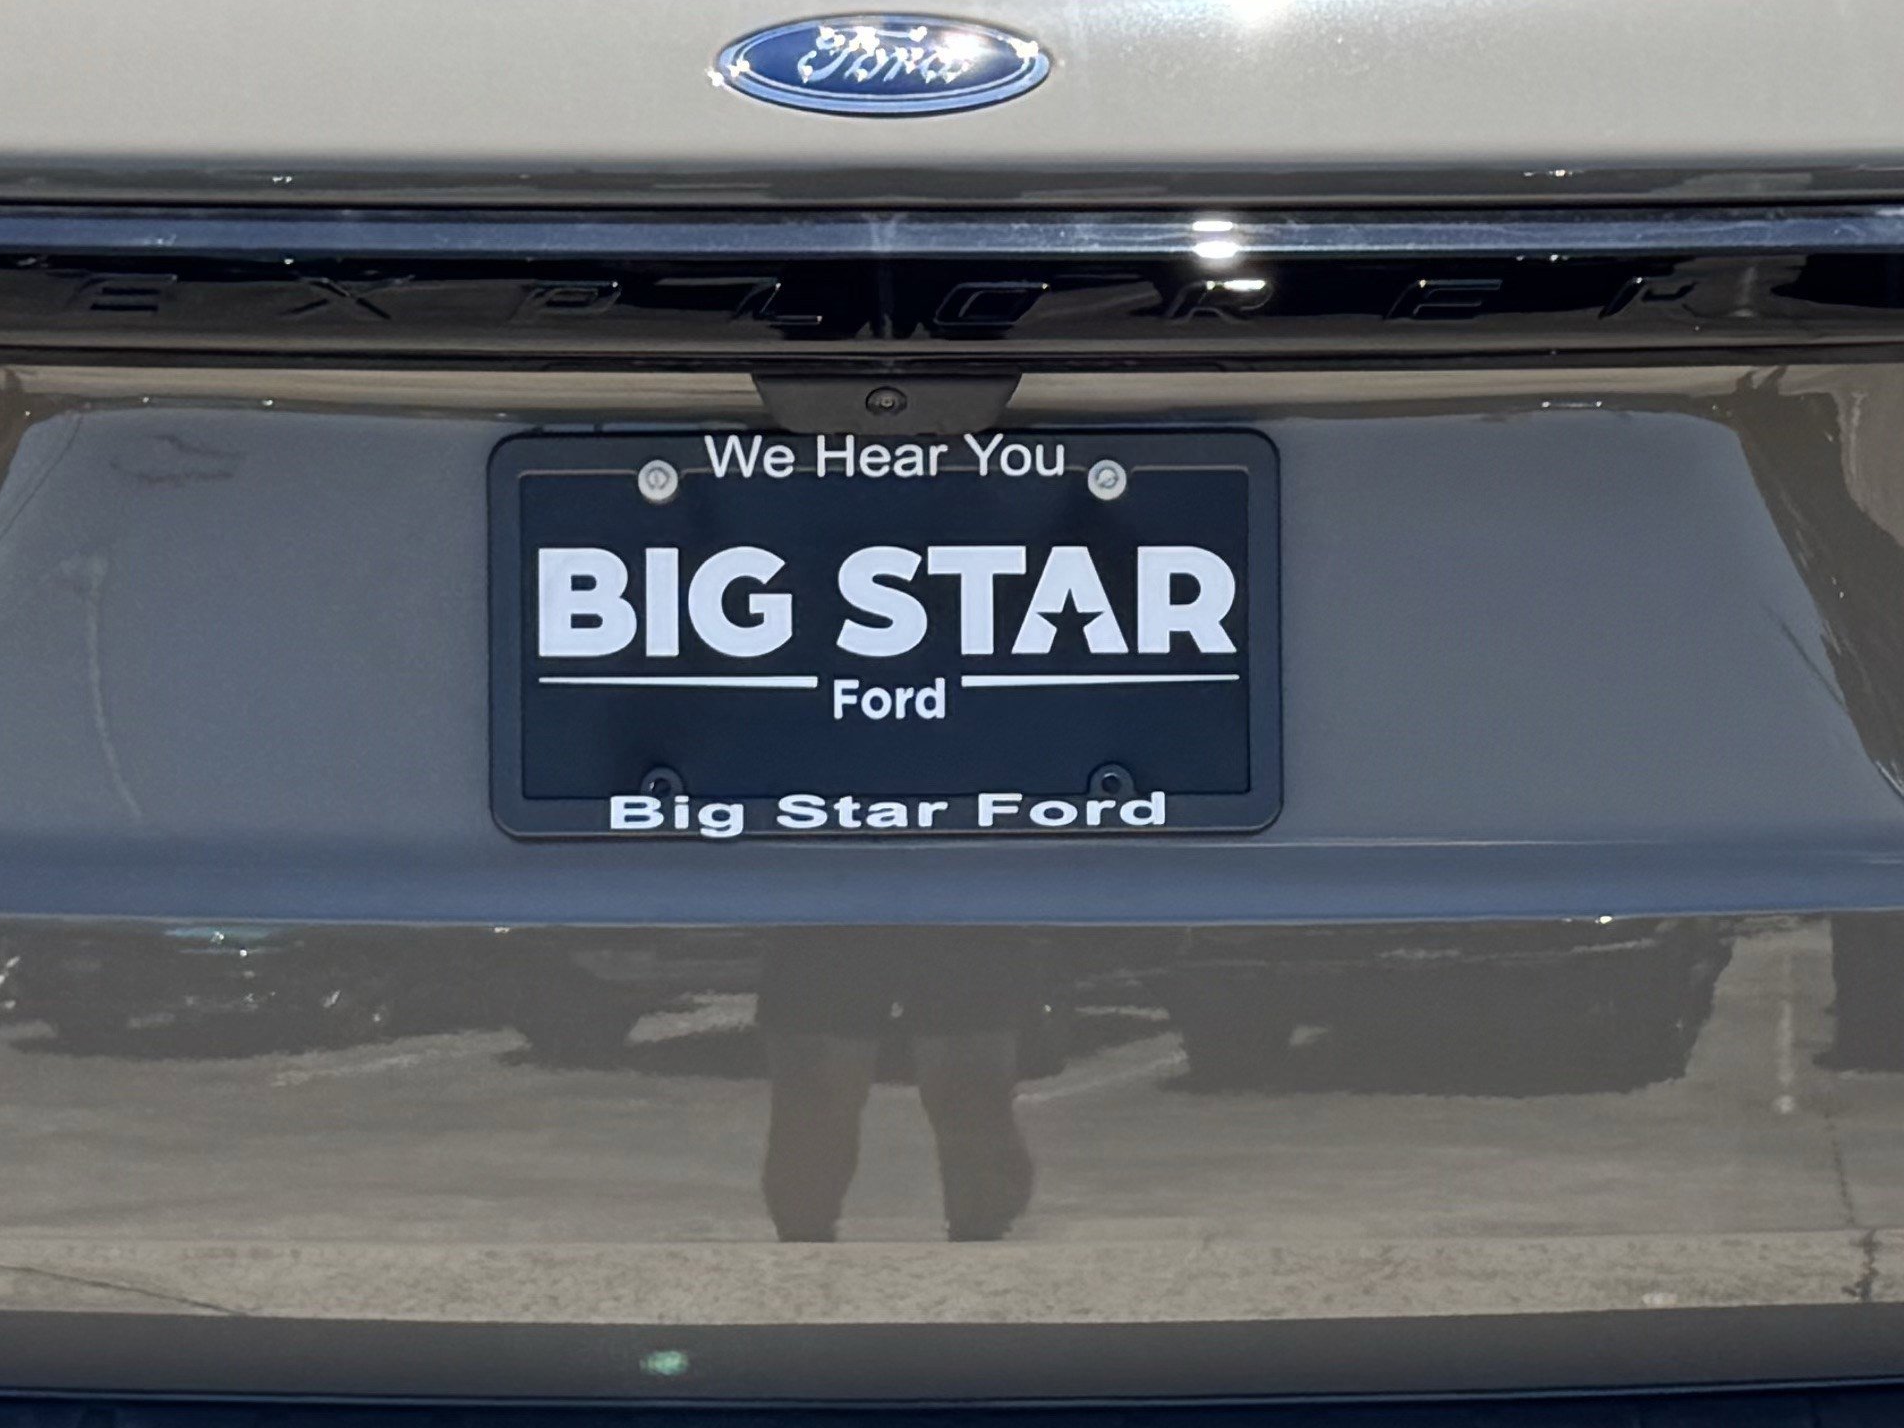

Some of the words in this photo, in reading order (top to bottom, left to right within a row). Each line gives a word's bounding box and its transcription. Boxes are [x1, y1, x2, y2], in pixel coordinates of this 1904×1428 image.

[795, 25, 980, 84] Ford
[705, 434, 795, 479] We
[817, 434, 949, 479] Hear
[964, 432, 1066, 478] You
[538, 545, 794, 659] BIG
[836, 545, 1238, 659] STAR
[833, 677, 947, 721] Ford
[609, 794, 745, 839] Big
[776, 793, 950, 830] Star
[977, 791, 1167, 828] Ford
